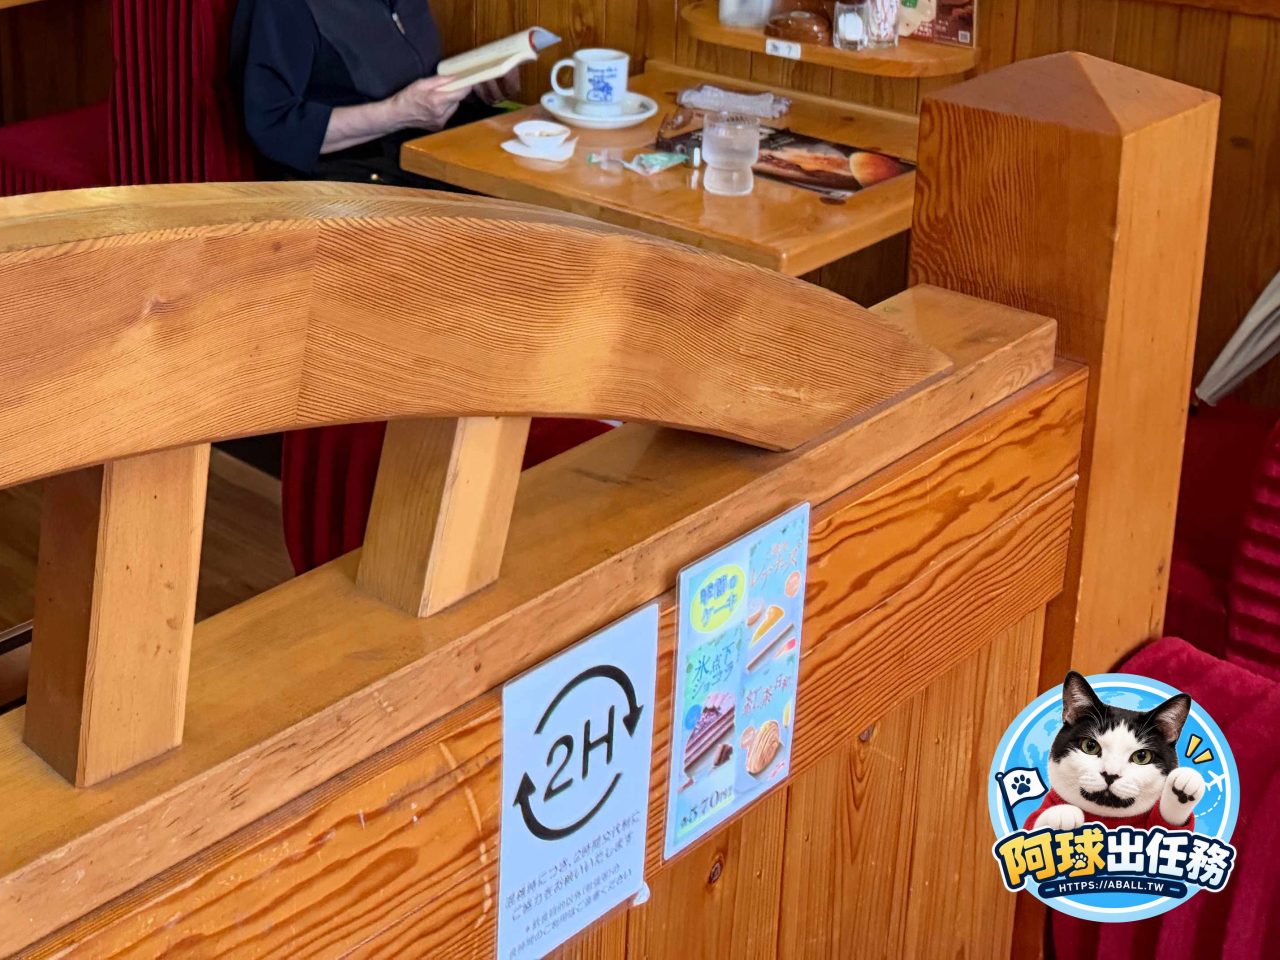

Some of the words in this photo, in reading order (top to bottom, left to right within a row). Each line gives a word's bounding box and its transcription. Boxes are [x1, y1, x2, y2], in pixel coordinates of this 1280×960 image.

[693, 641, 735, 680] 氷点下
[543, 704, 615, 802] 2H
